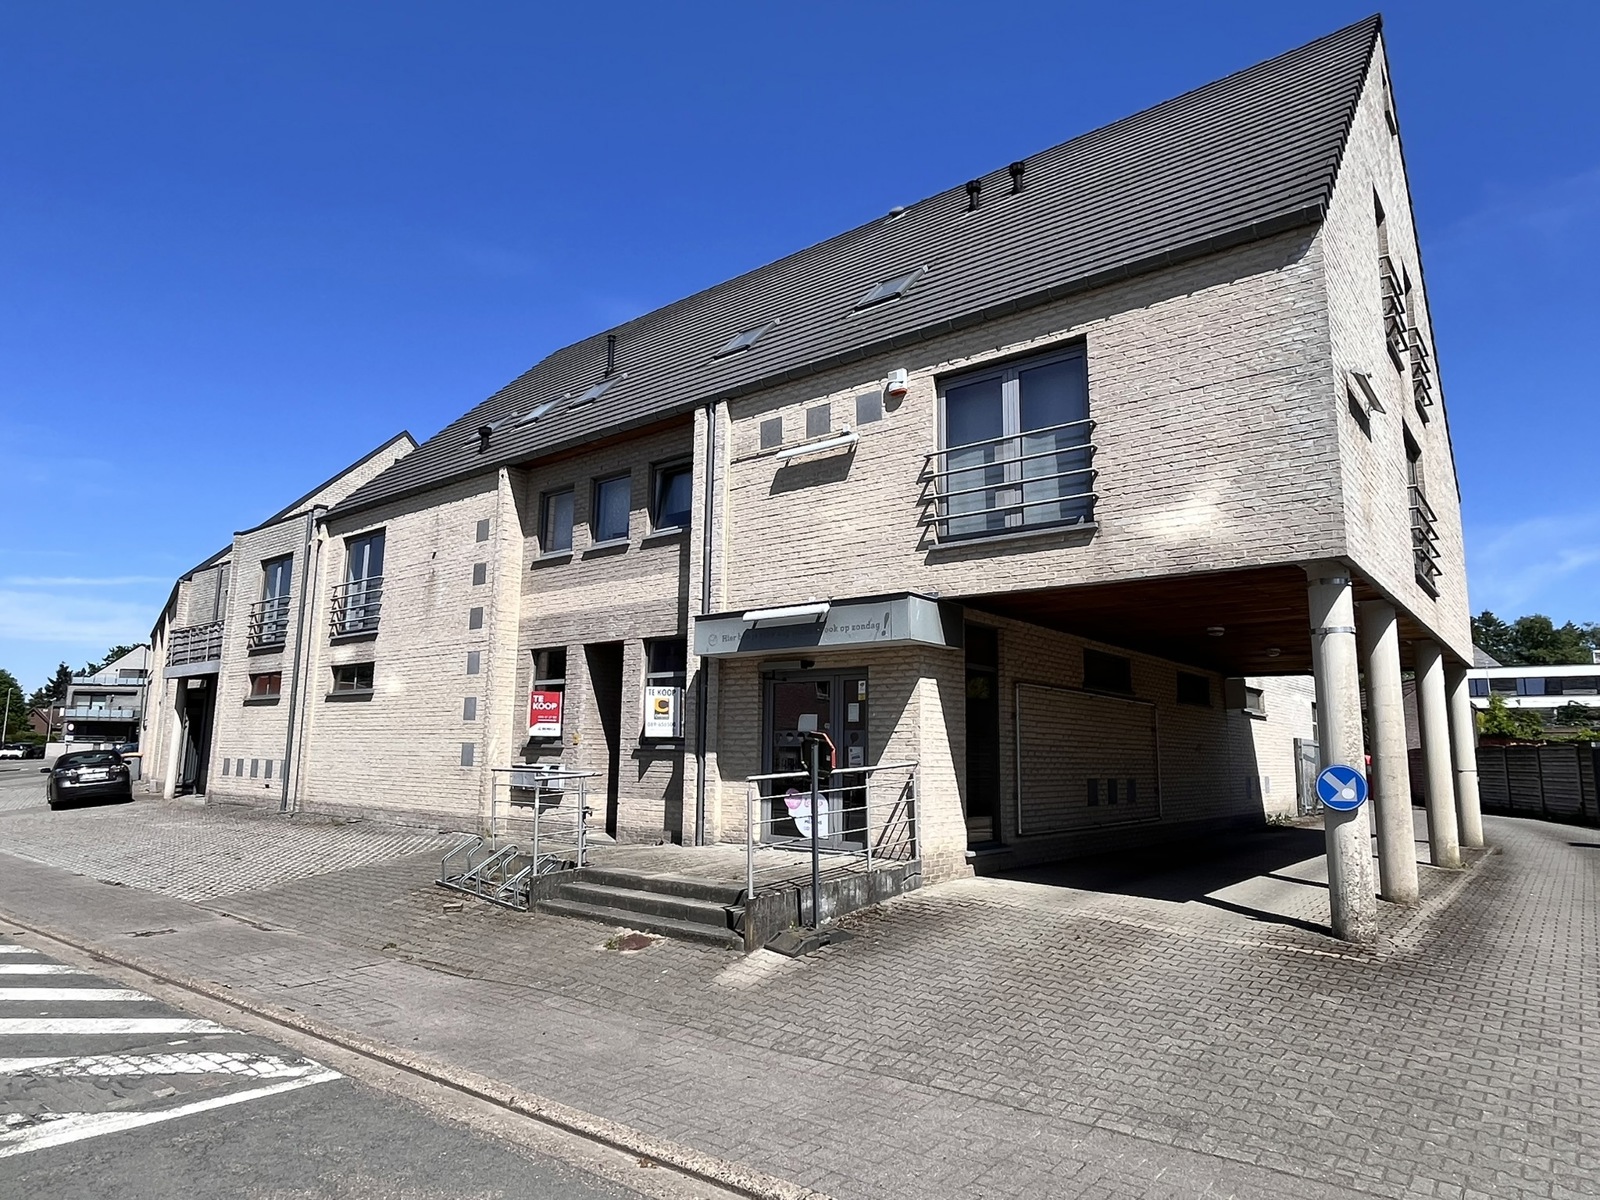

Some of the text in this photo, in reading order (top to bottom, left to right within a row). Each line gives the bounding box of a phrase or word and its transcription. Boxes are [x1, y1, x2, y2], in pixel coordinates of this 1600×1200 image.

[825, 623, 838, 633] ook
[840, 624, 850, 634] op
[648, 688, 676, 697] TE KOOP
[533, 702, 558, 710] KOOP
